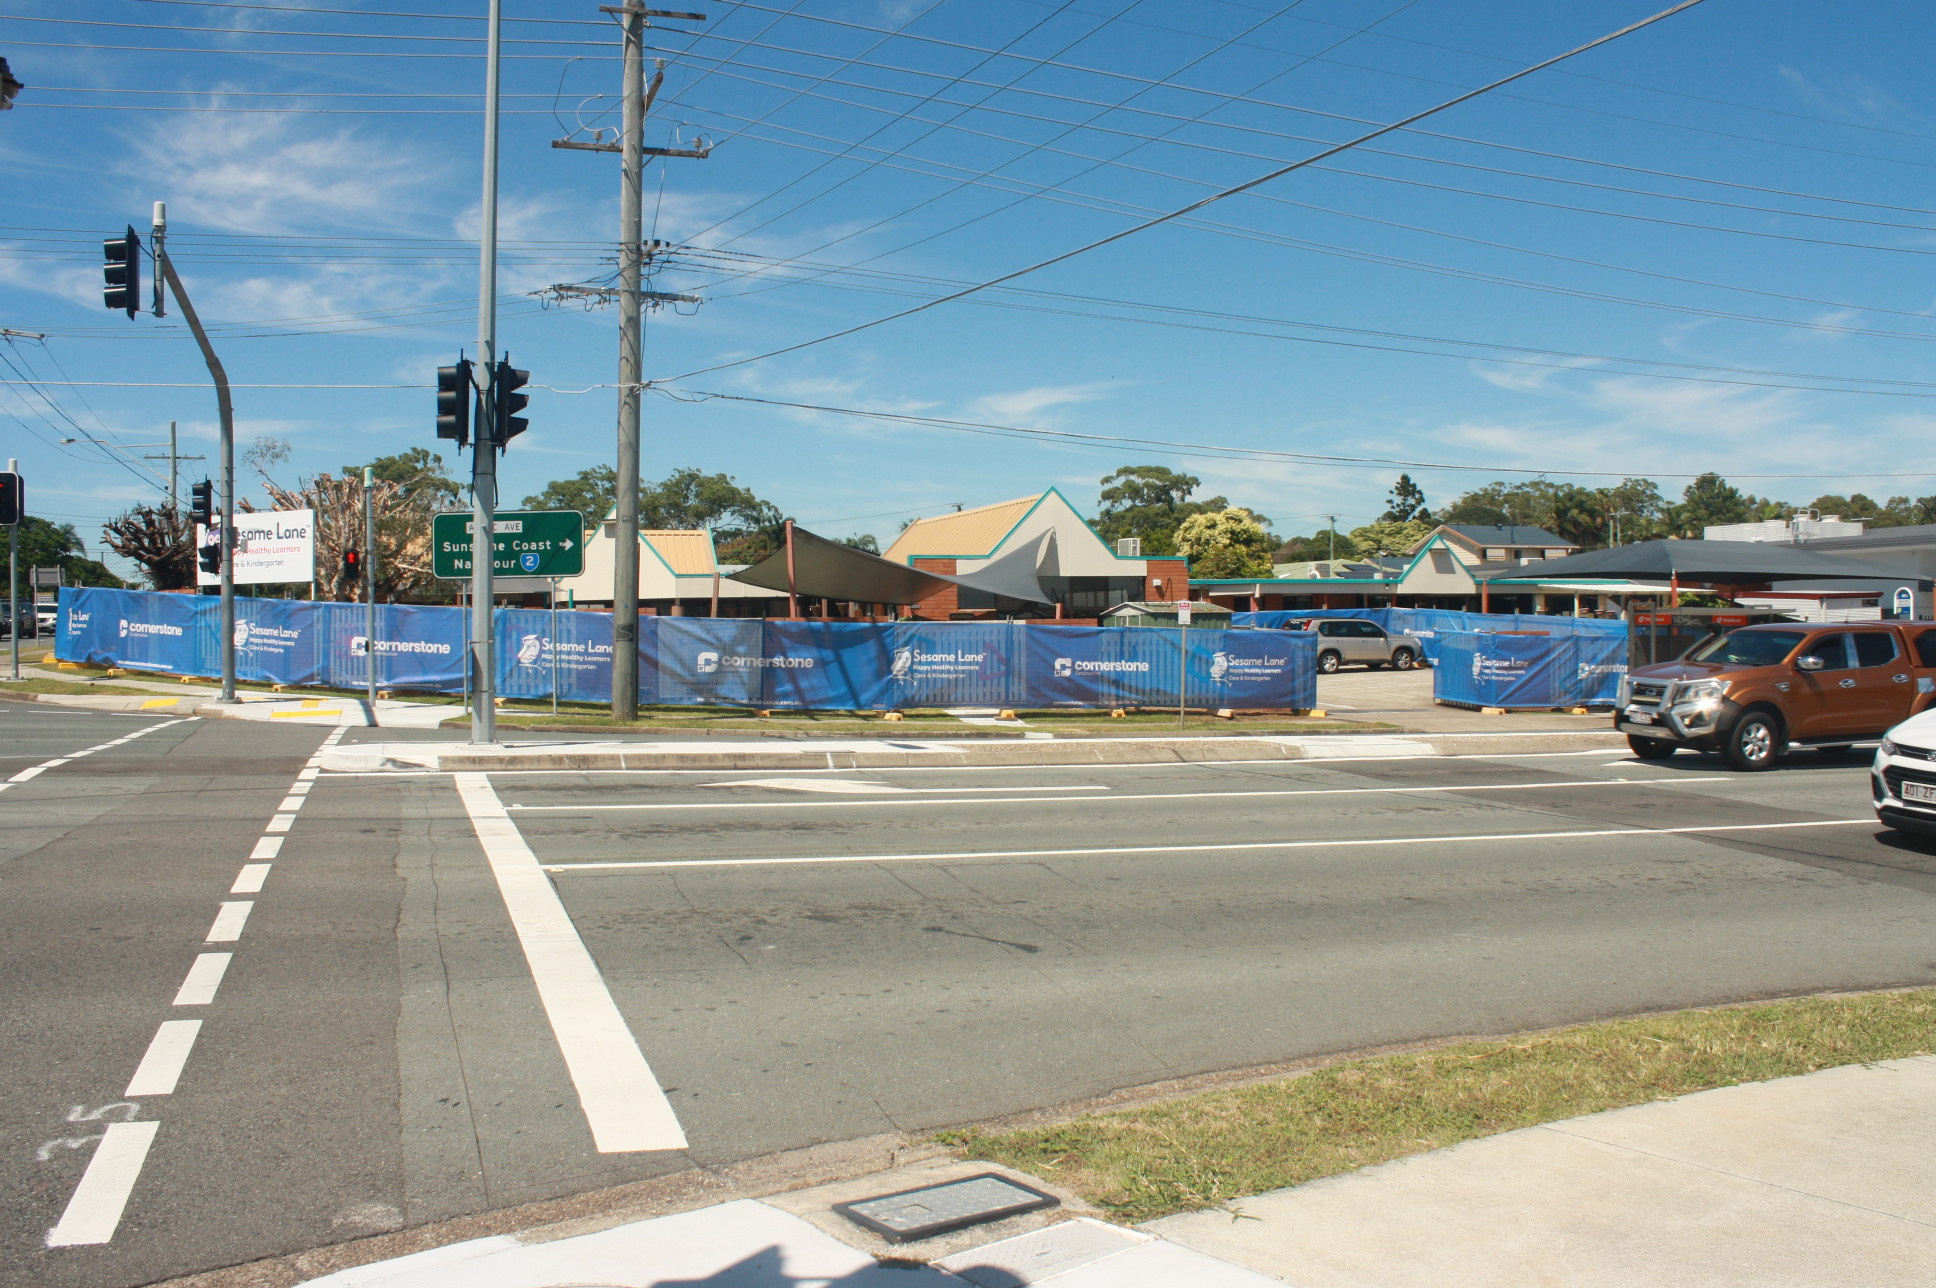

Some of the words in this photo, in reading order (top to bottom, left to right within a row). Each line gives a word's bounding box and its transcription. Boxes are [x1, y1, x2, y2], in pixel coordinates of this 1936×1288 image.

[505, 522, 520, 531] AVE
[272, 546, 301, 554] Learners
[443, 541, 505, 552] Sunsne
[513, 540, 551, 550] Coast
[246, 559, 285, 569] Kindergarten
[454, 559, 516, 569] Naour
[526, 556, 534, 566] 2
[129, 622, 183, 636] cornerstone
[249, 622, 279, 637] Sesame
[279, 625, 299, 639] Lane
[722, 655, 814, 669] cornerstone
[913, 649, 956, 662] Sesame
[958, 649, 984, 662] Lane
[1228, 654, 1263, 667] Sesame
[1264, 654, 1285, 667] Lane
[1074, 660, 1150, 672] cornerstone
